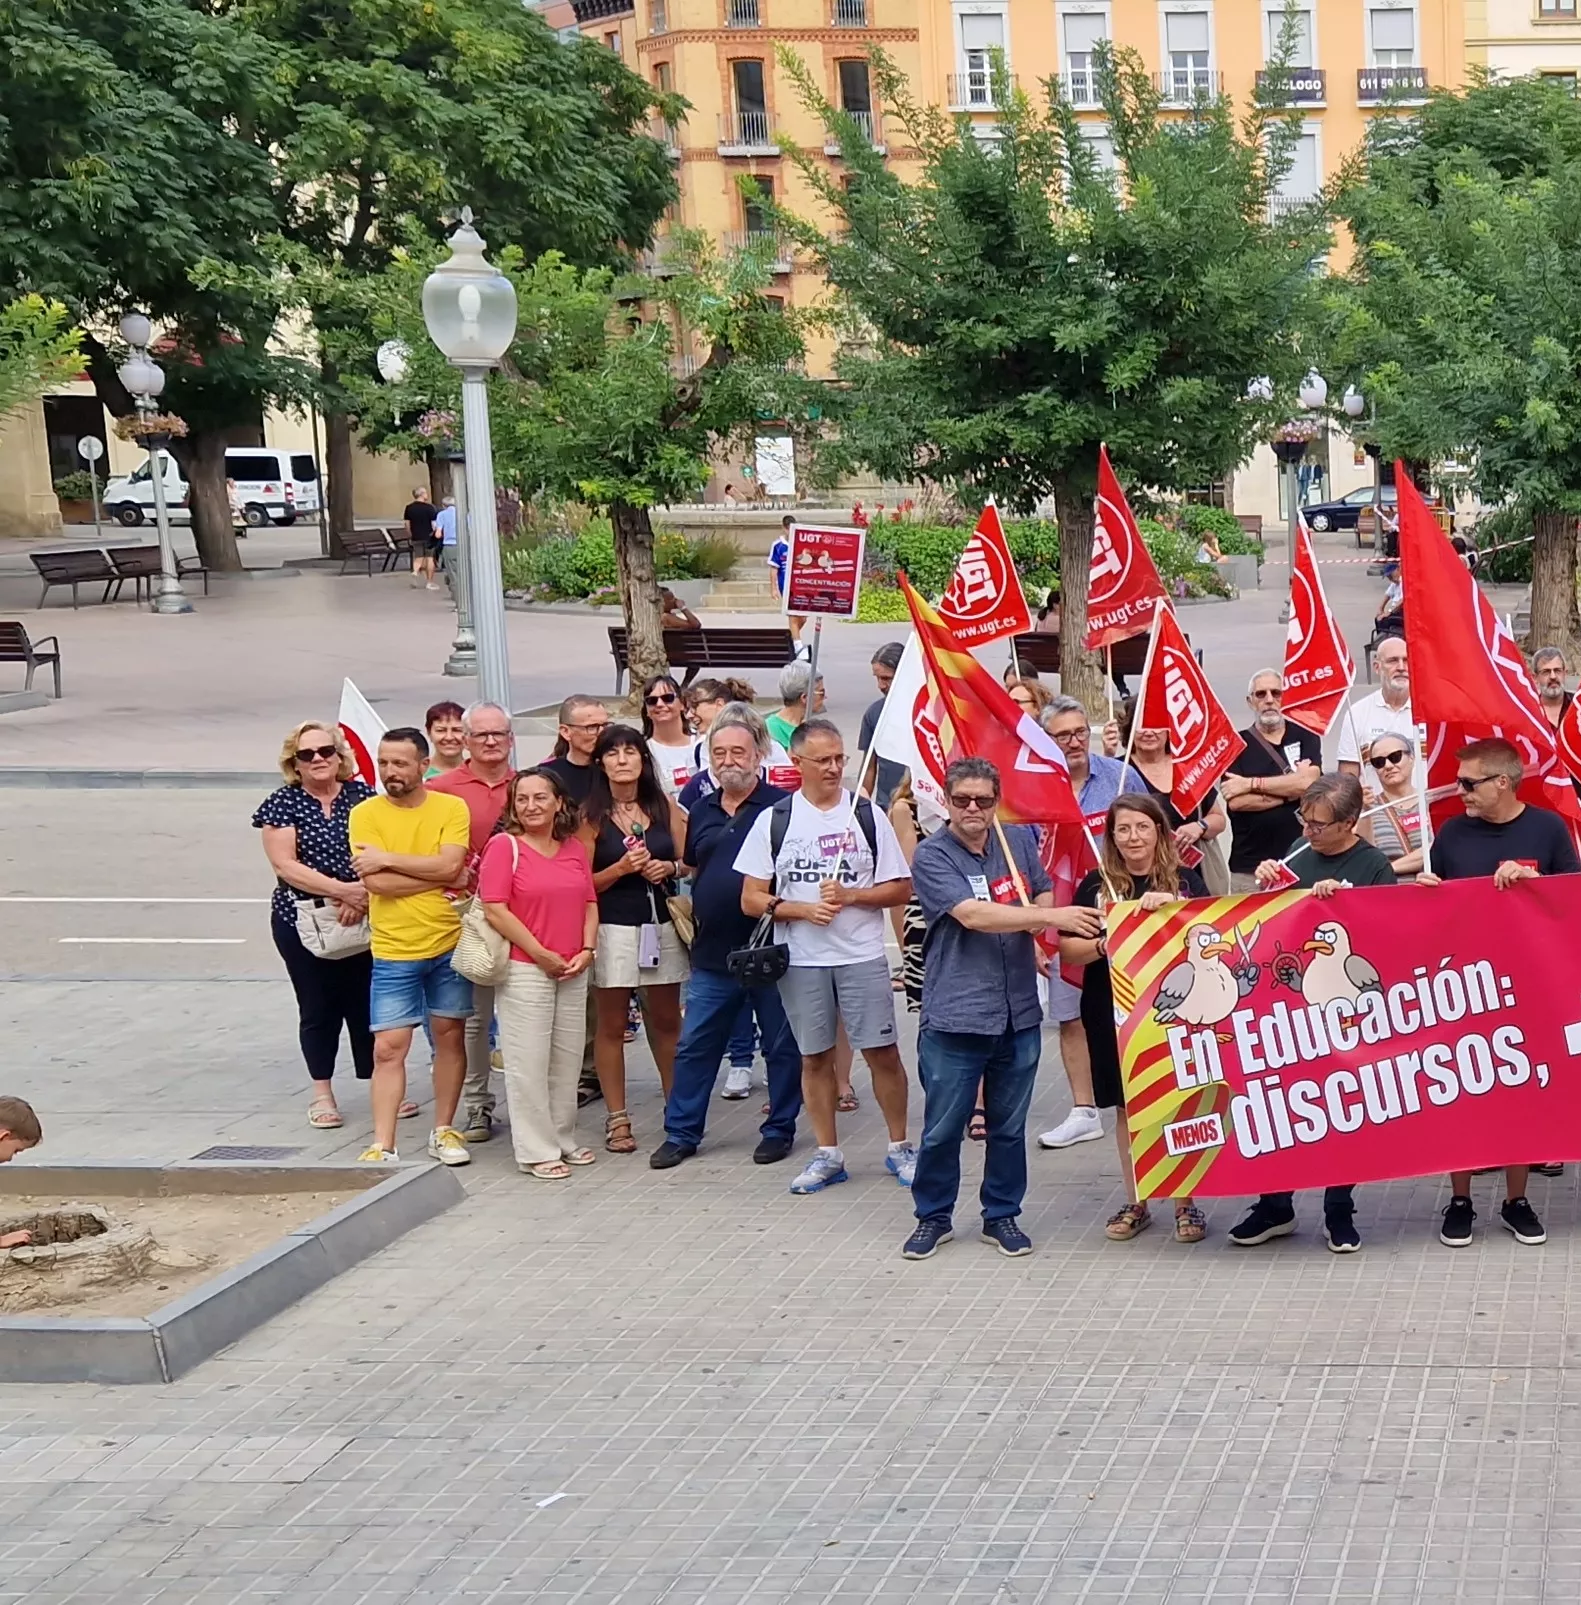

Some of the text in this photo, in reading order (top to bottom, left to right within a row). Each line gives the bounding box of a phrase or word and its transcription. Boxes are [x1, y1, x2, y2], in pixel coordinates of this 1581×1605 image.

[799, 532, 821, 543] UGT
[1177, 735, 1230, 795] www.ugt.es
[1166, 955, 1516, 1091] En Educación:
[1171, 1025, 1549, 1158] MENOS discursos,
